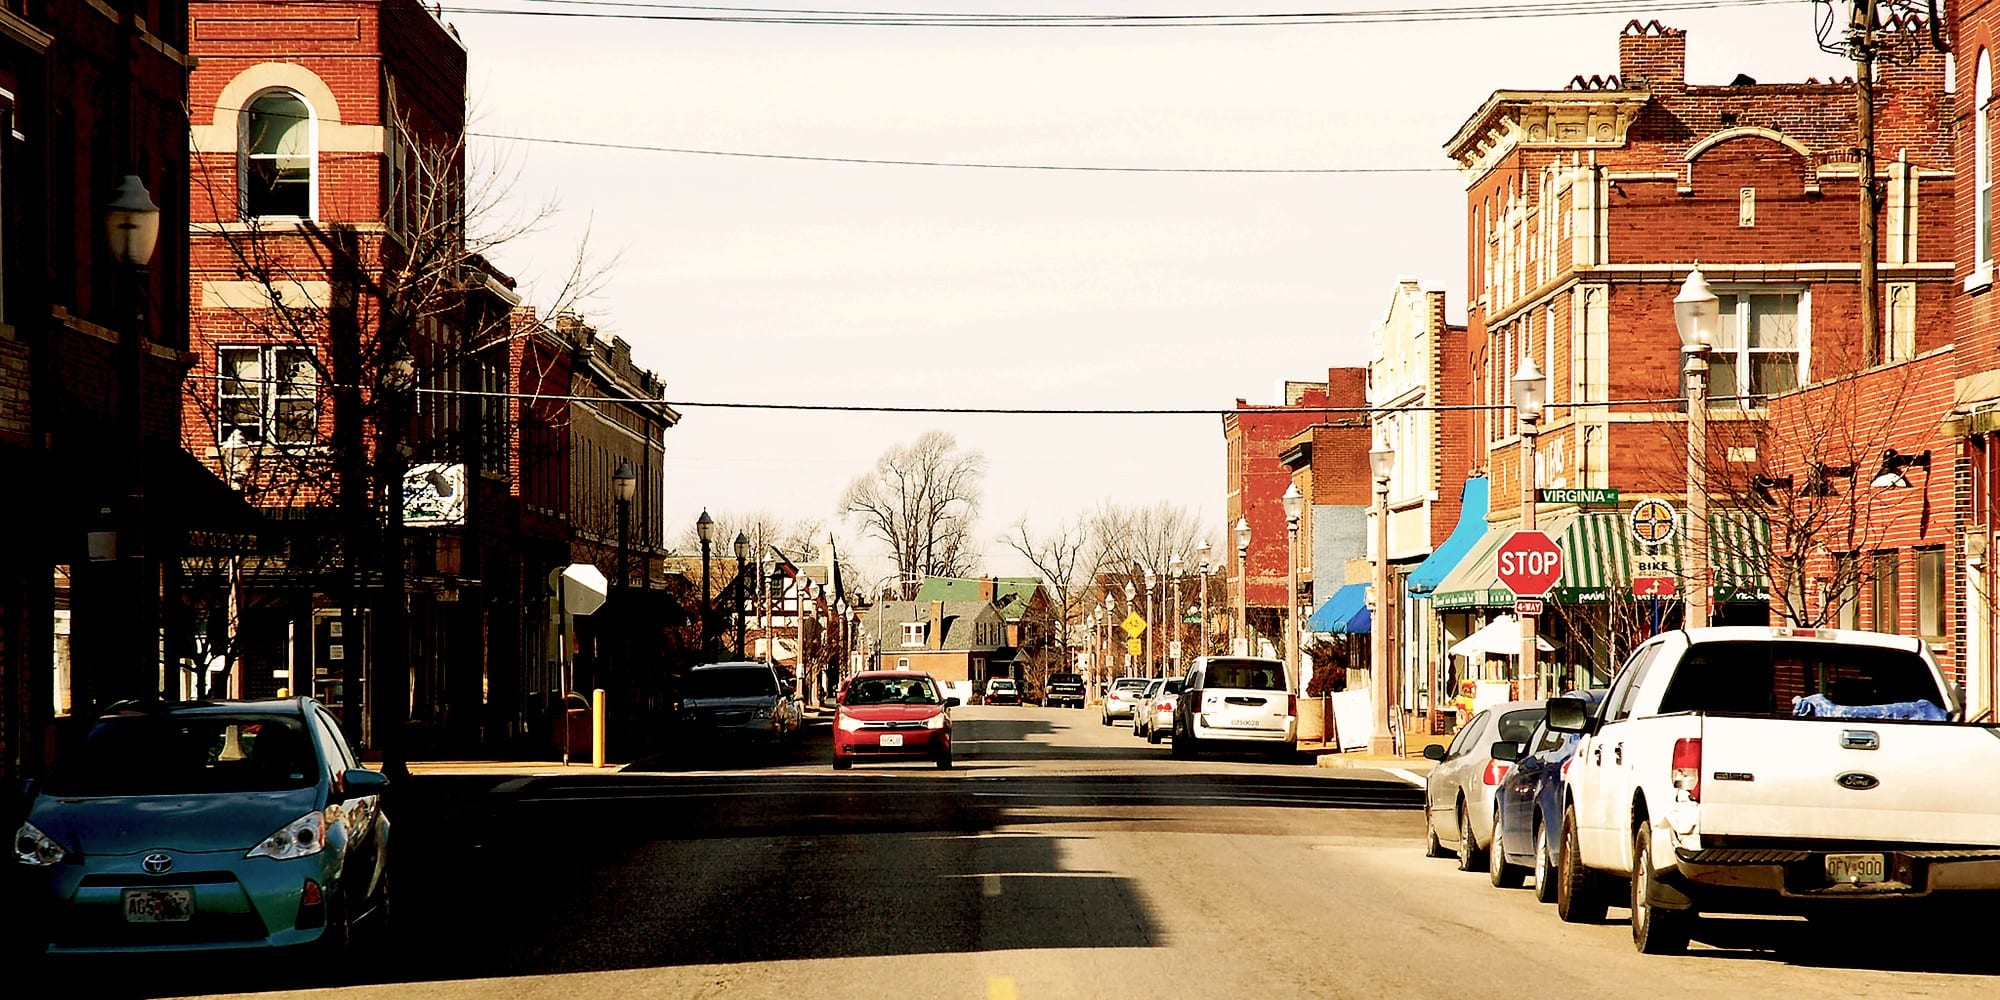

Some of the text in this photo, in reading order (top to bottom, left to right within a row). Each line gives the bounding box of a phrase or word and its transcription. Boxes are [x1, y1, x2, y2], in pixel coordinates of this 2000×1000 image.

[1543, 490, 1606, 502] VIRGINIA
[1501, 551, 1558, 576] STOP
[1639, 562, 1668, 571] BIKE
[1578, 591, 1606, 604] panini
[1517, 603, 1541, 612] 4-WAY
